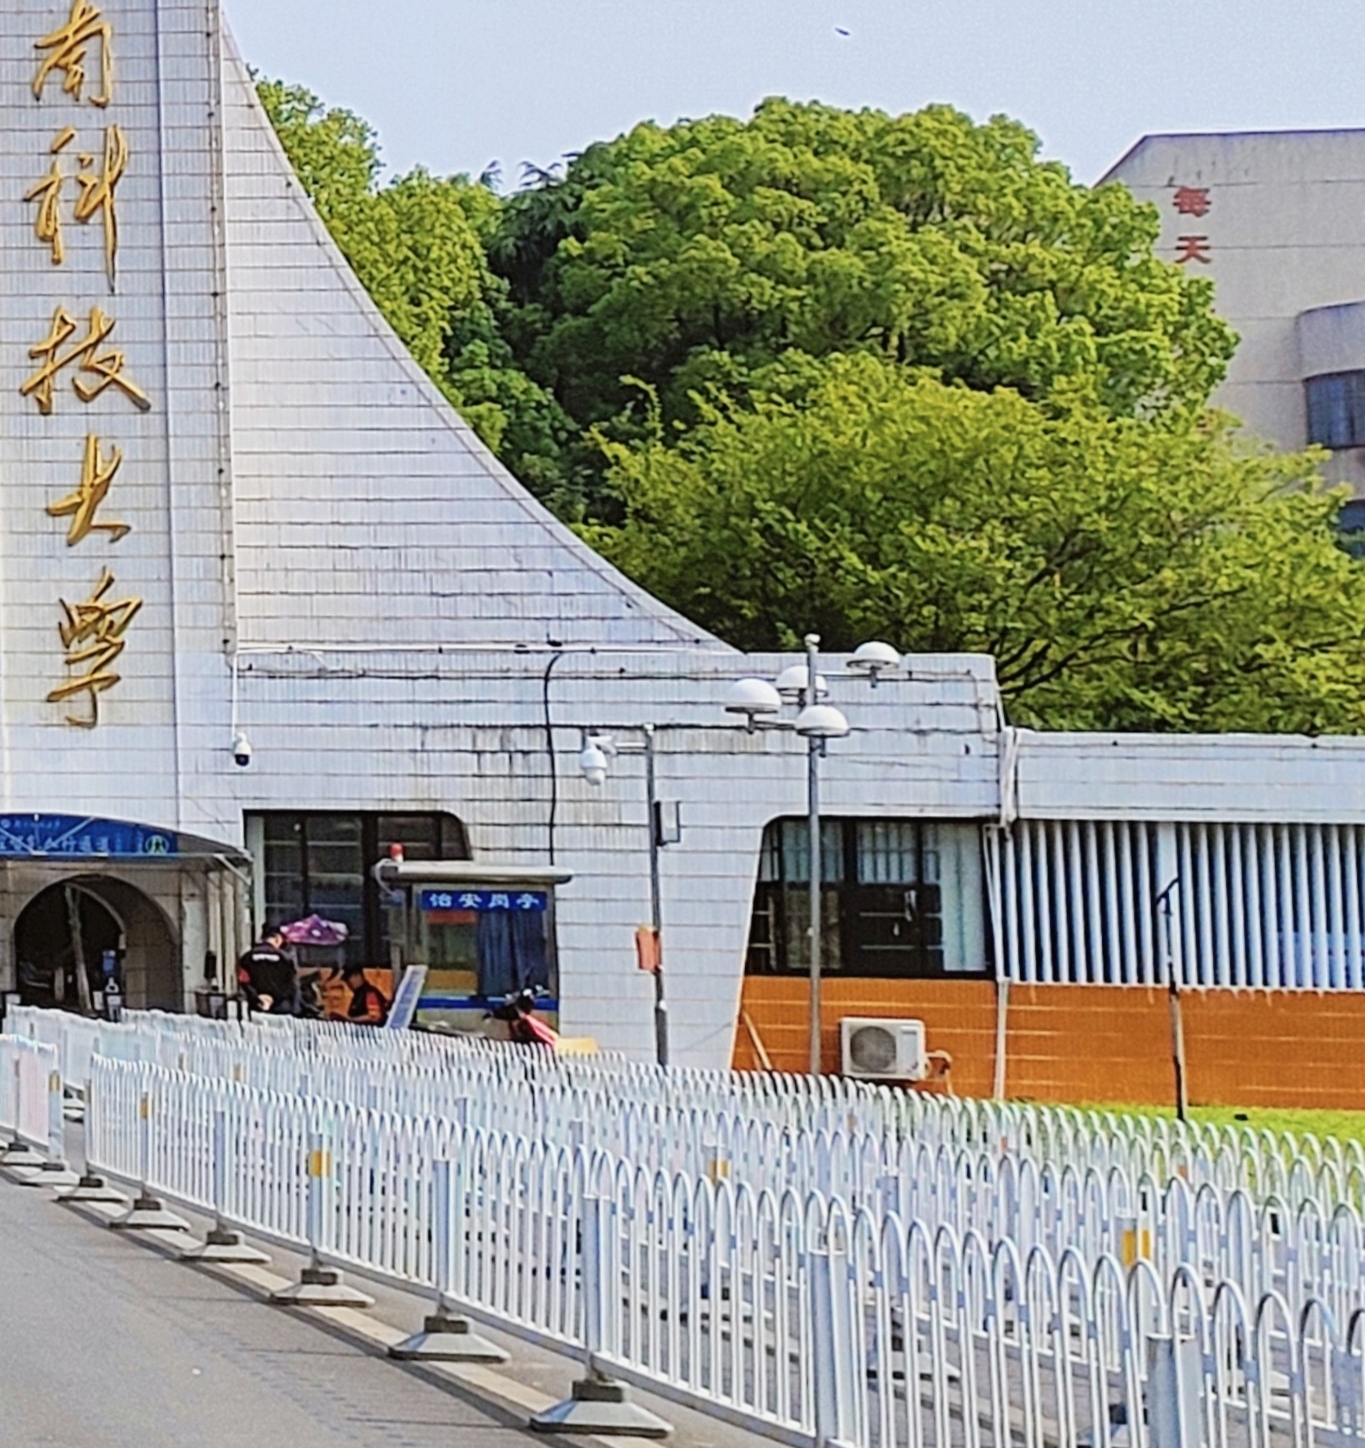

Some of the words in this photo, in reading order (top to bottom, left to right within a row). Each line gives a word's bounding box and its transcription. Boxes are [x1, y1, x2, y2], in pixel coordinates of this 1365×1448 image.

[1173, 187, 1212, 264] 每天
[429, 893, 540, 910] 治安岗亭
